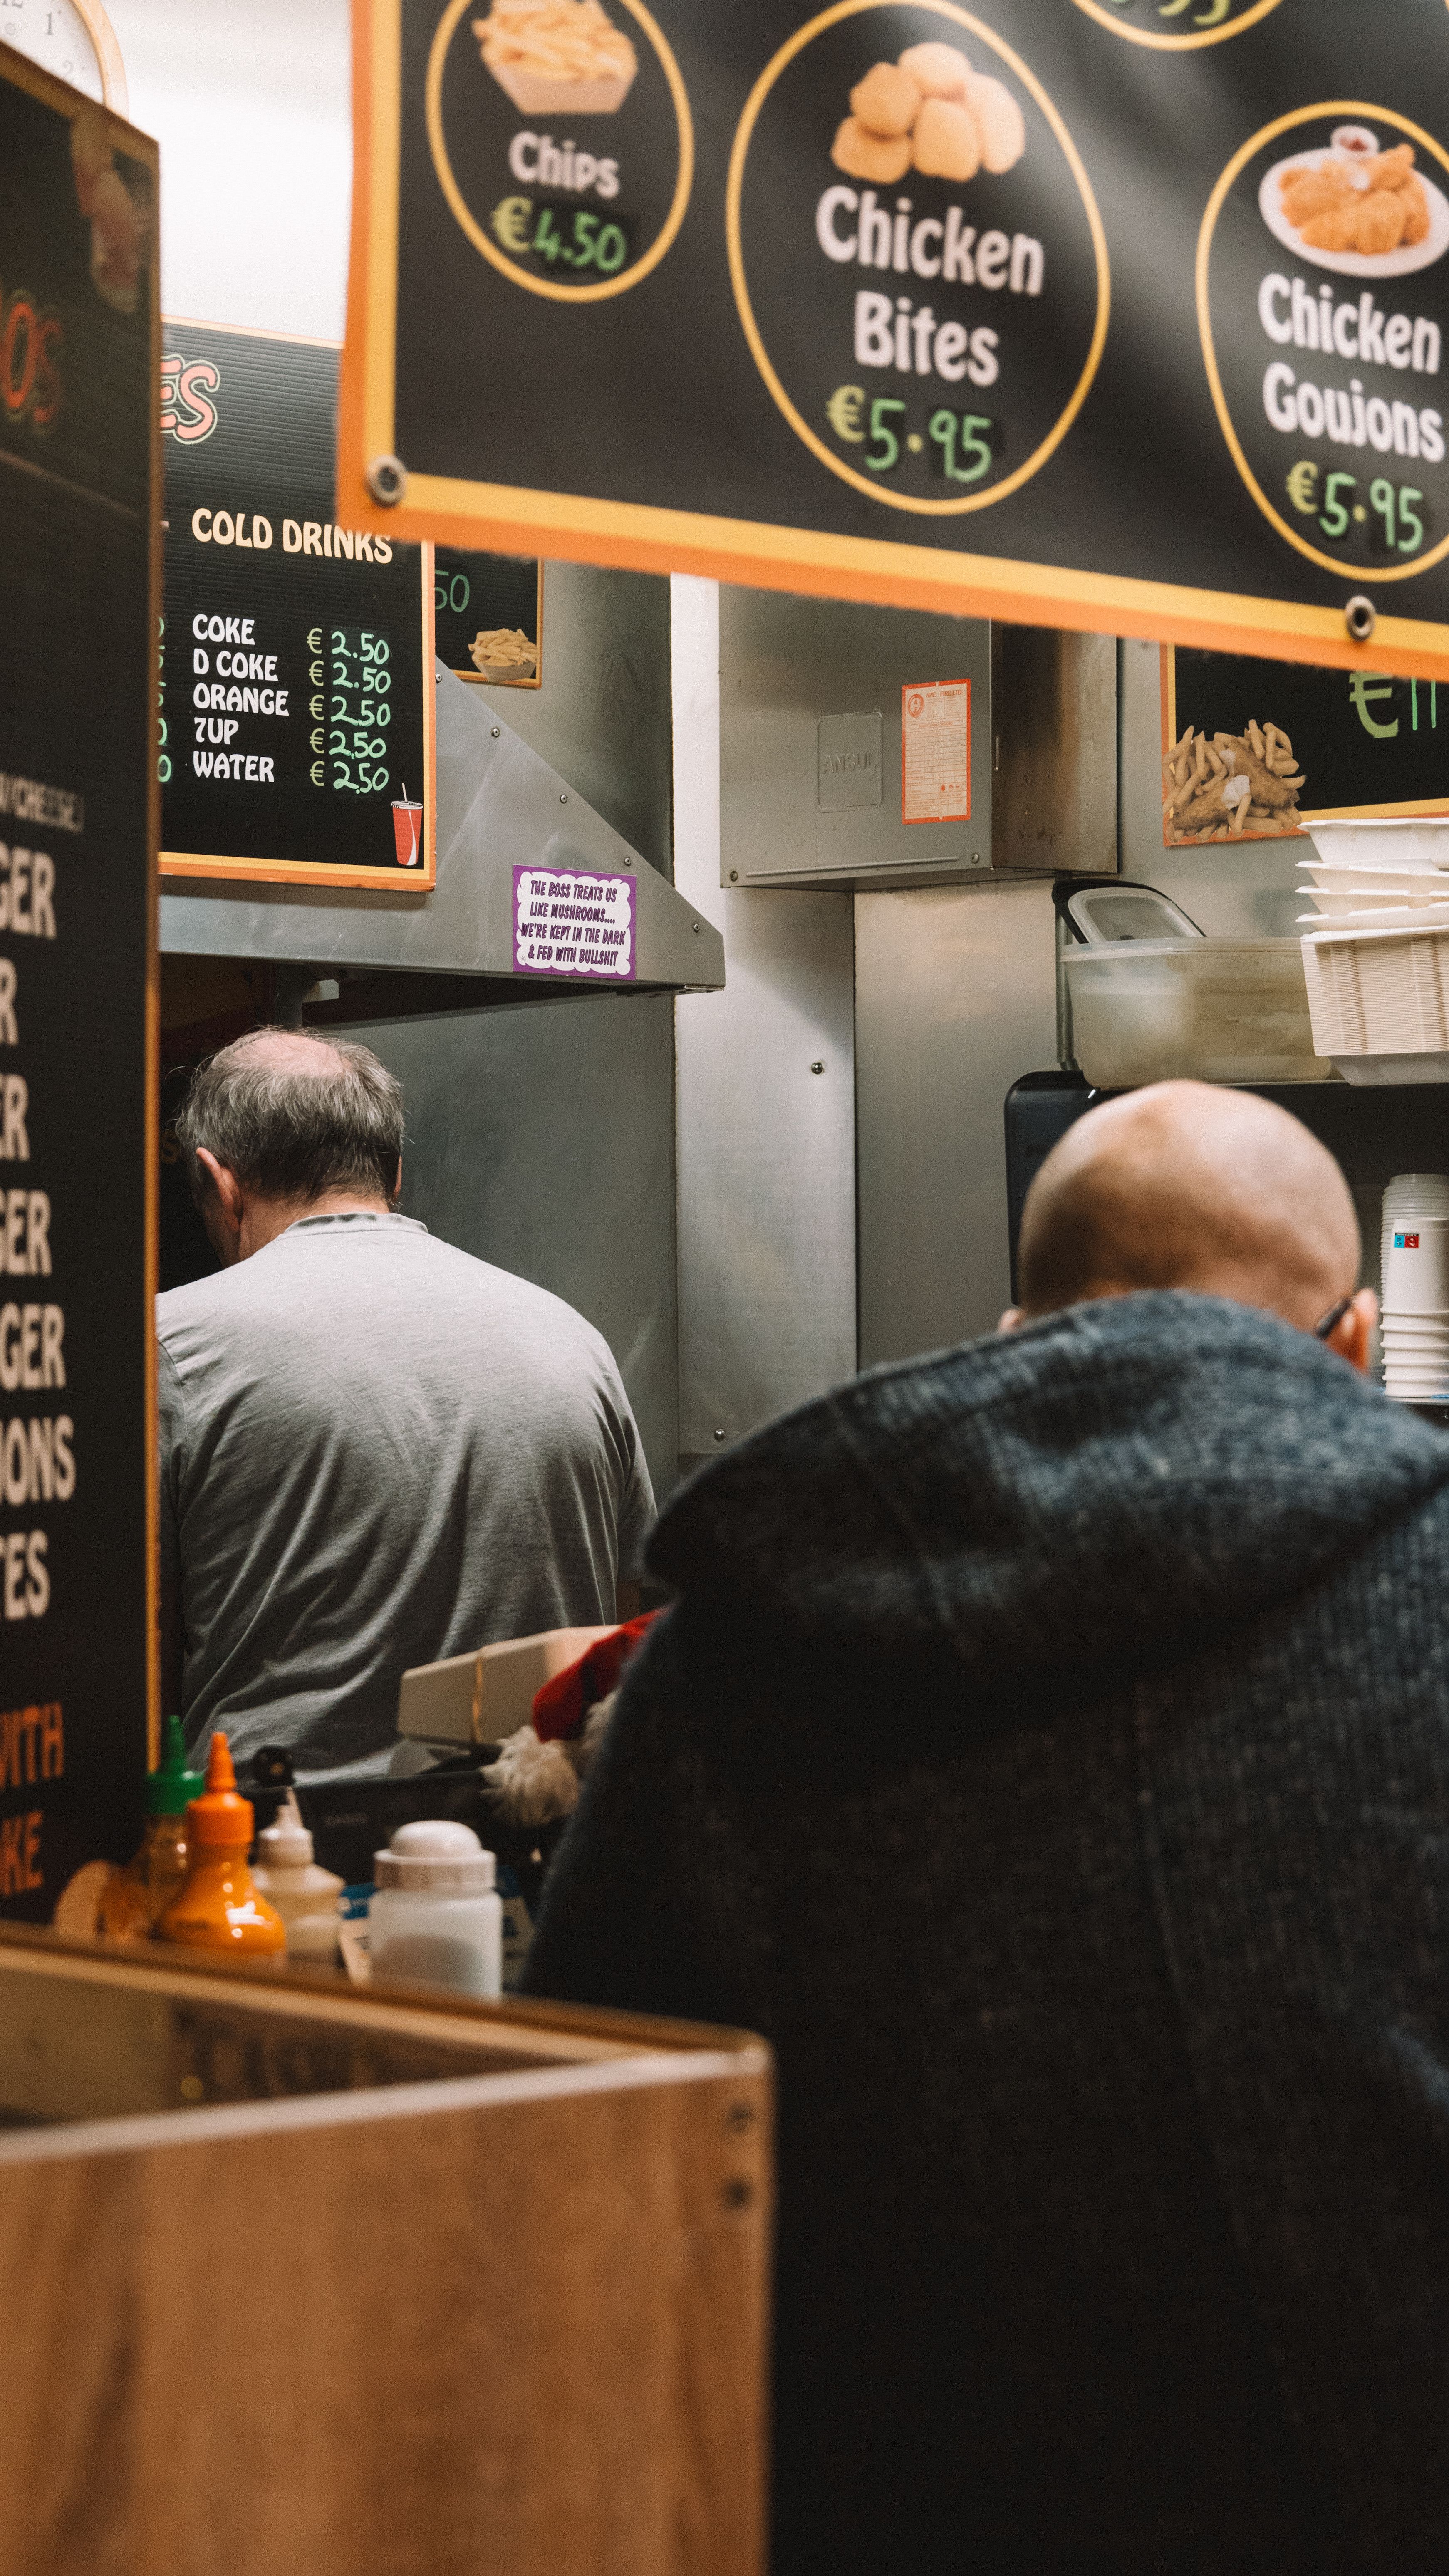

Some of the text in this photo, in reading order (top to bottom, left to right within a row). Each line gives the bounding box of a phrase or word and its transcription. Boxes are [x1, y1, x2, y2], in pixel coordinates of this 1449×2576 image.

[46, 12, 54, 36] 1
[508, 131, 620, 199] Chips
[815, 185, 1045, 296] Chicken
[854, 290, 999, 387] Bites
[1258, 272, 1441, 374] Chicken
[1262, 362, 1445, 463] Goujons
[192, 508, 393, 564] COLD DRINKS
[192, 614, 255, 645] COKE
[193, 648, 209, 674] D
[216, 652, 278, 681] COKE
[193, 683, 290, 716] ORANGE
[194, 717, 239, 745] 7UP
[193, 751, 275, 783] WATER
[530, 880, 617, 903] THE BOSS TREATS US
[530, 901, 549, 917] LIKE
[521, 922, 626, 946] WE'RE KEPT IN THE DARK
[528, 944, 619, 966] & FED WITH BULLSHIT
[0, 1189, 52, 1276] ER
[0, 1302, 66, 1390] GER
